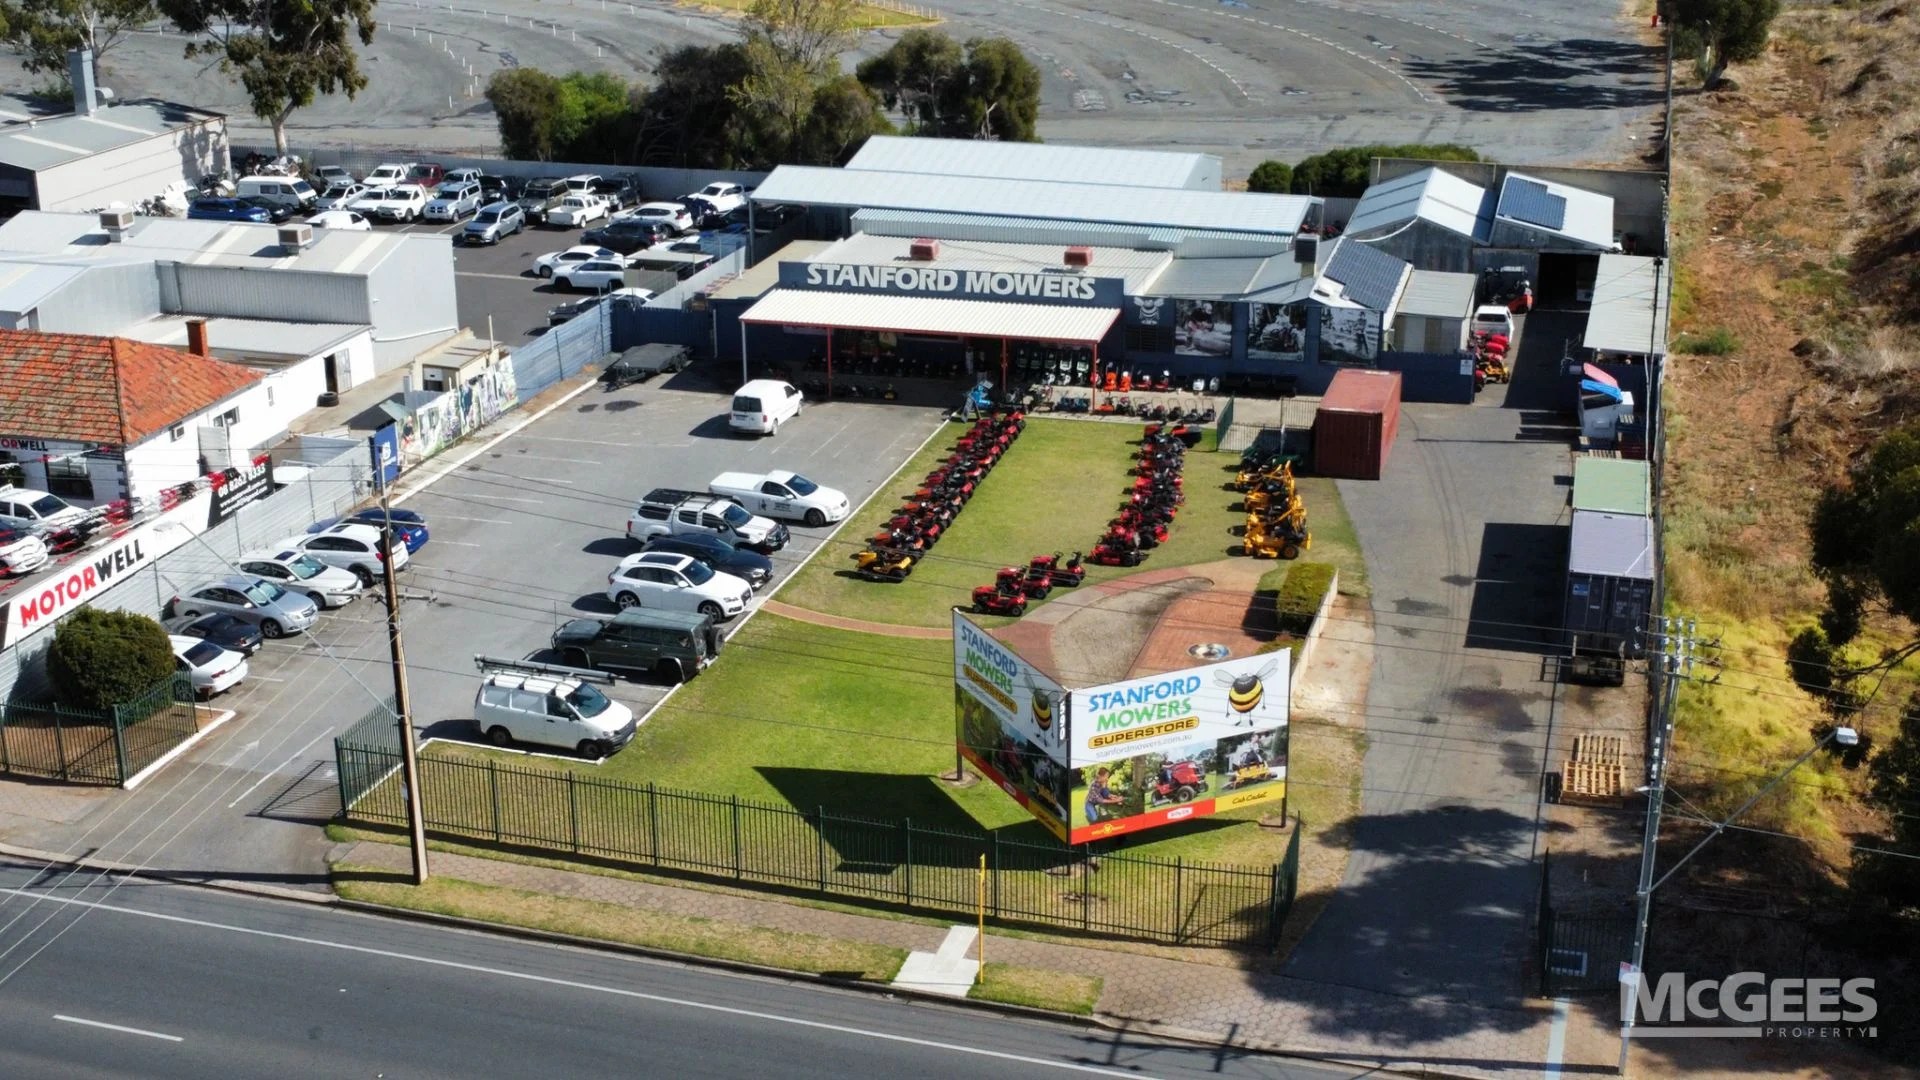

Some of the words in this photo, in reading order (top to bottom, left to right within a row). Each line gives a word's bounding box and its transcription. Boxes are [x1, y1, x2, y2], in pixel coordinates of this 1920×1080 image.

[807, 263, 958, 292] STANFORD
[965, 272, 1096, 300] MOWERS
[20, 539, 145, 628] MOTORWELL
[961, 624, 1018, 678] STANFORD
[966, 647, 1013, 695] MOWERS
[1088, 675, 1201, 712] STANFORD
[1093, 719, 1195, 747] SUPERSTORE
[1096, 698, 1192, 732] MOWERS
